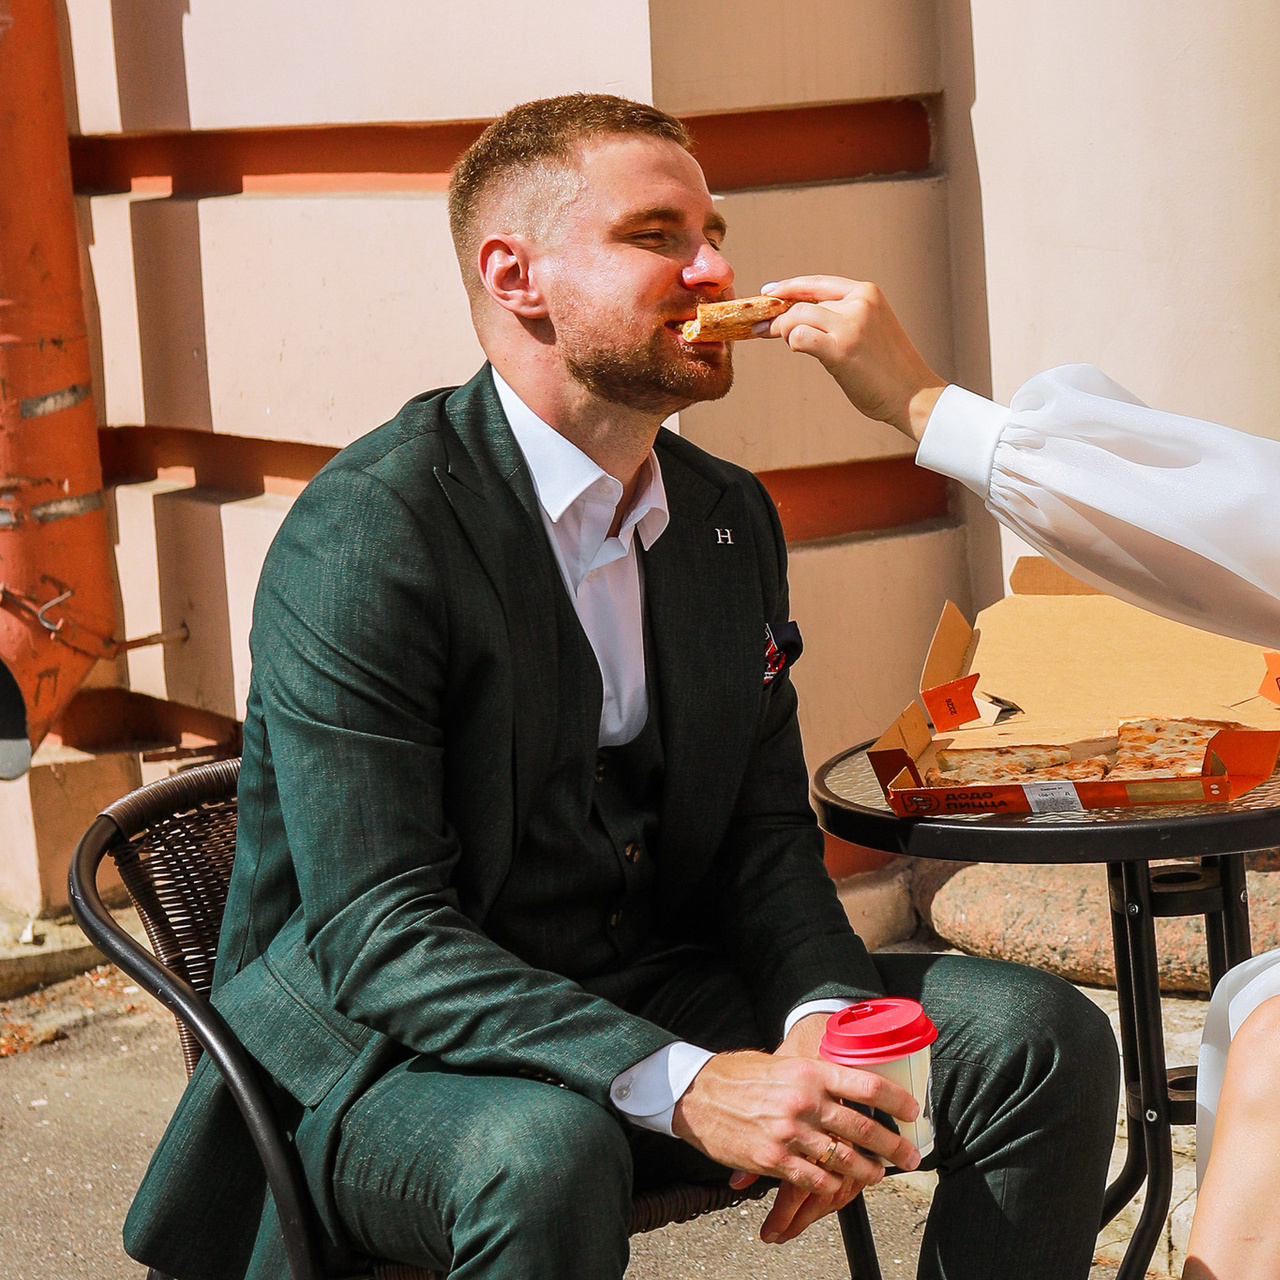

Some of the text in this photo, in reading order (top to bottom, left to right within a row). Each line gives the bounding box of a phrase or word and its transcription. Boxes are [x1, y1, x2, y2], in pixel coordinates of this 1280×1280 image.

[715, 528, 734, 545] H
[945, 791, 994, 802] ДОДО
[946, 800, 1009, 810] ПИЦЦА
